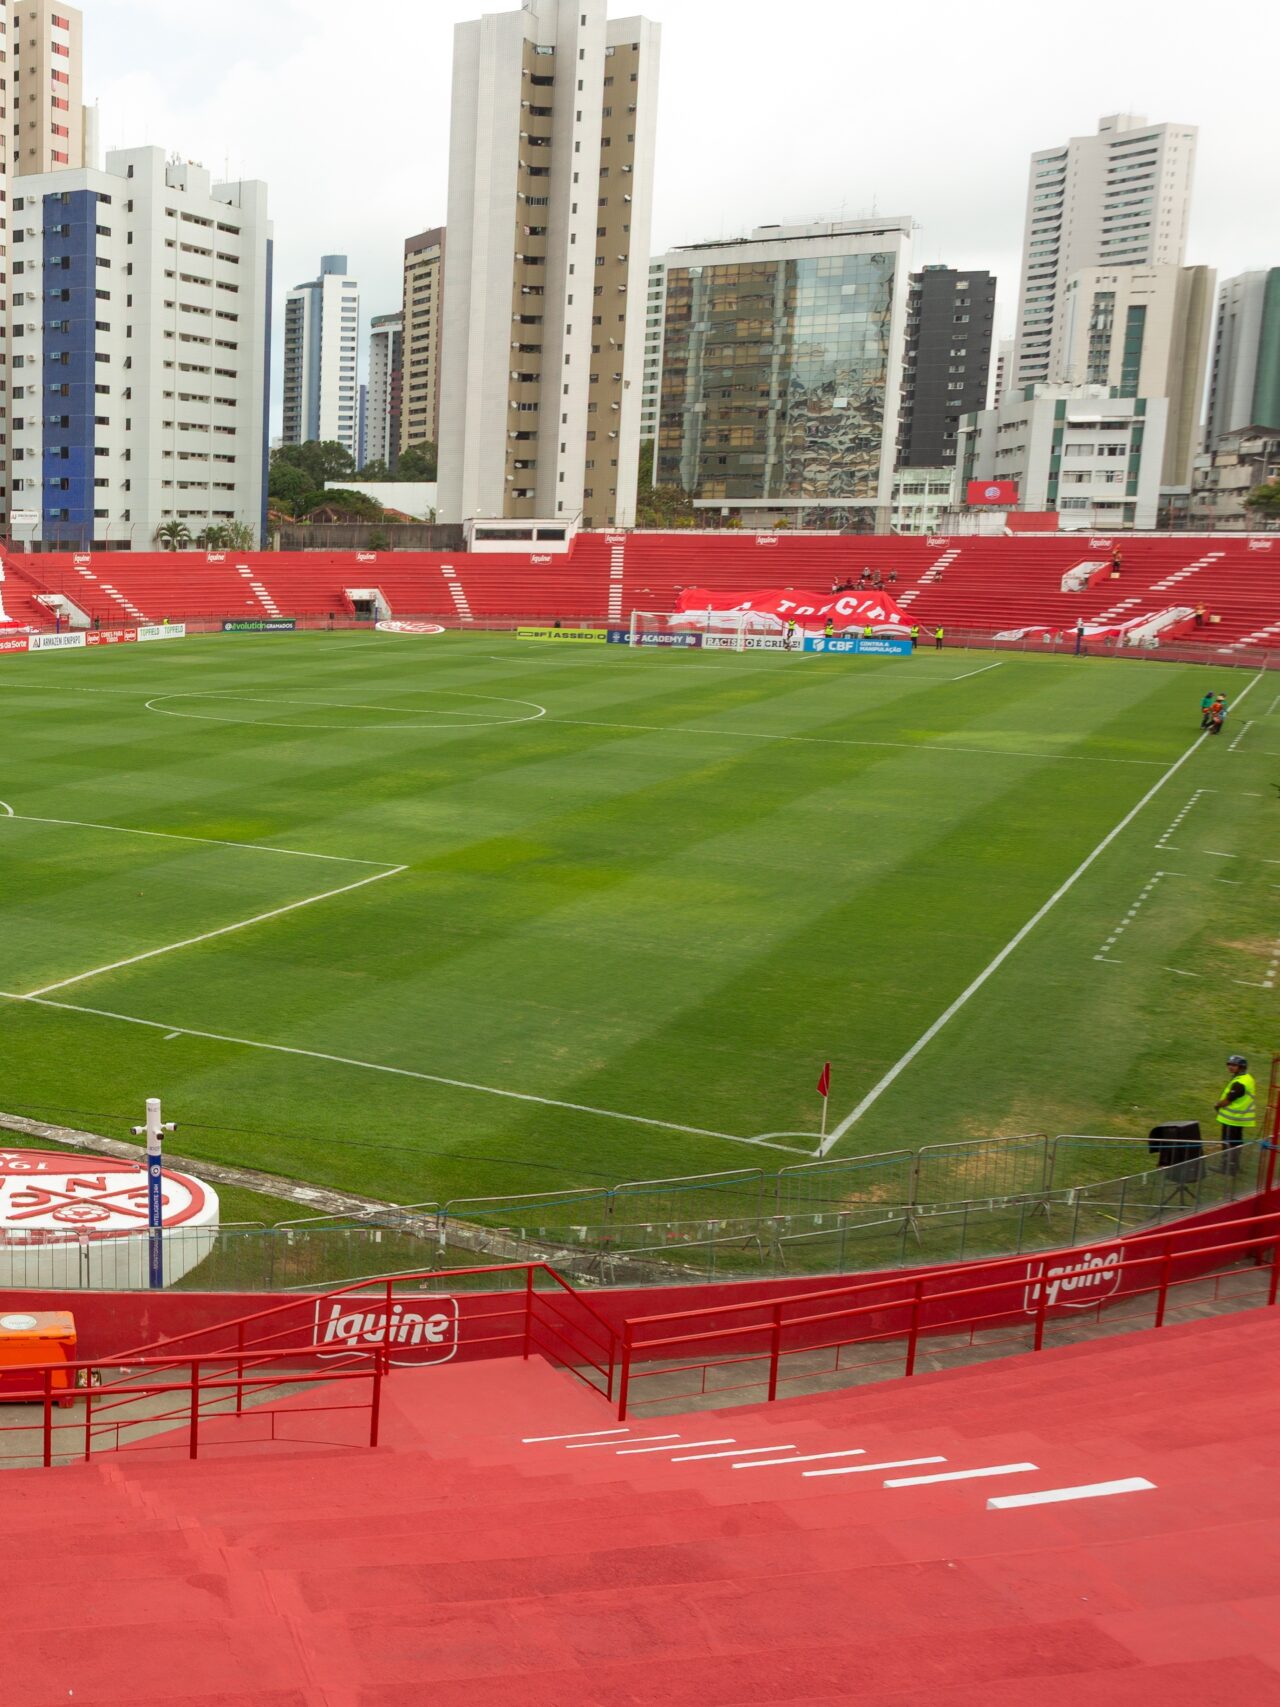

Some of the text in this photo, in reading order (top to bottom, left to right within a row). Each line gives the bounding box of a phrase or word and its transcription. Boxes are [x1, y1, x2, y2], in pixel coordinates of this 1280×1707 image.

[756, 536, 777, 544] Iquine
[1090, 538, 1112, 548] Iquine
[642, 635, 682, 644] ACADEMY
[706, 637, 754, 648] RACISO
[765, 638, 800, 648] CRIE!
[829, 640, 854, 651] CBF
[1031, 1252, 1118, 1306] Iquine
[324, 1304, 449, 1346] Iquine
